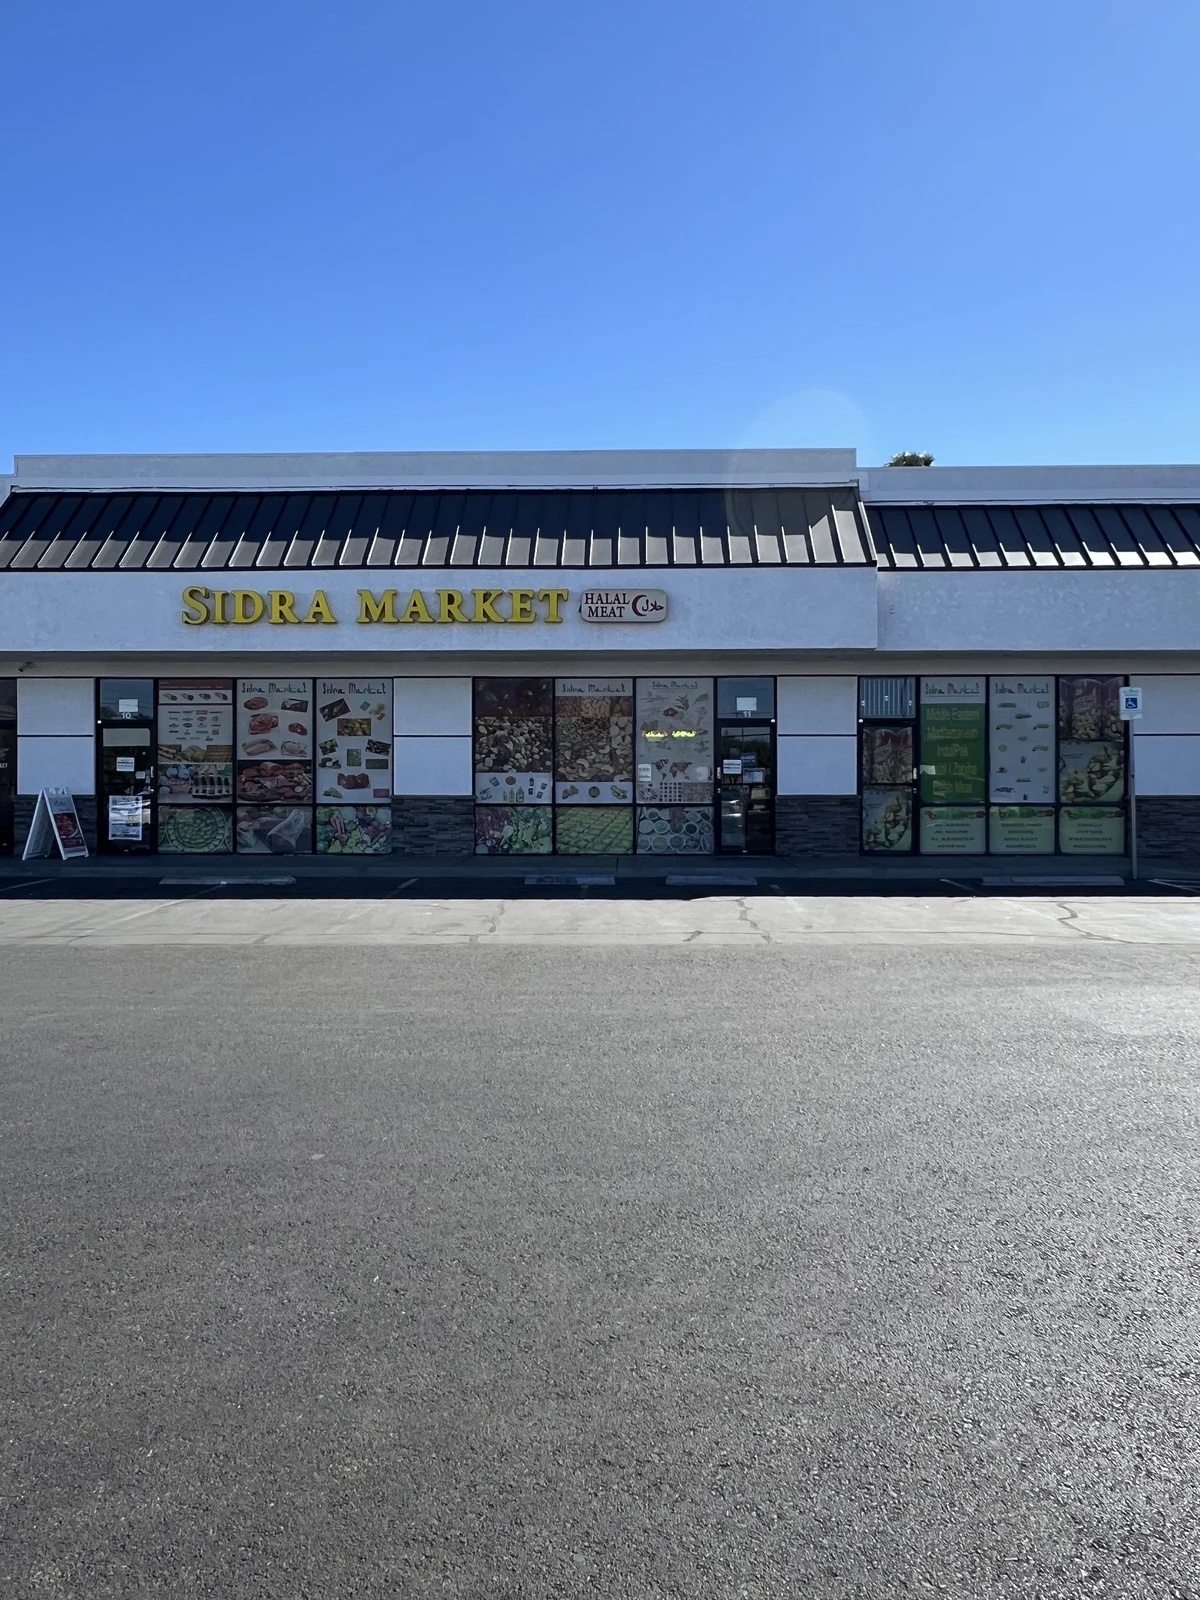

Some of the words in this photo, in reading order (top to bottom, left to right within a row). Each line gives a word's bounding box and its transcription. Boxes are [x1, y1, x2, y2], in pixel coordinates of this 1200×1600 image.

[181, 585, 339, 625] SIDRA
[356, 588, 570, 624] MARKET
[584, 592, 630, 605] HALAL
[587, 605, 626, 618] MEAT
[121, 712, 132, 720] 10
